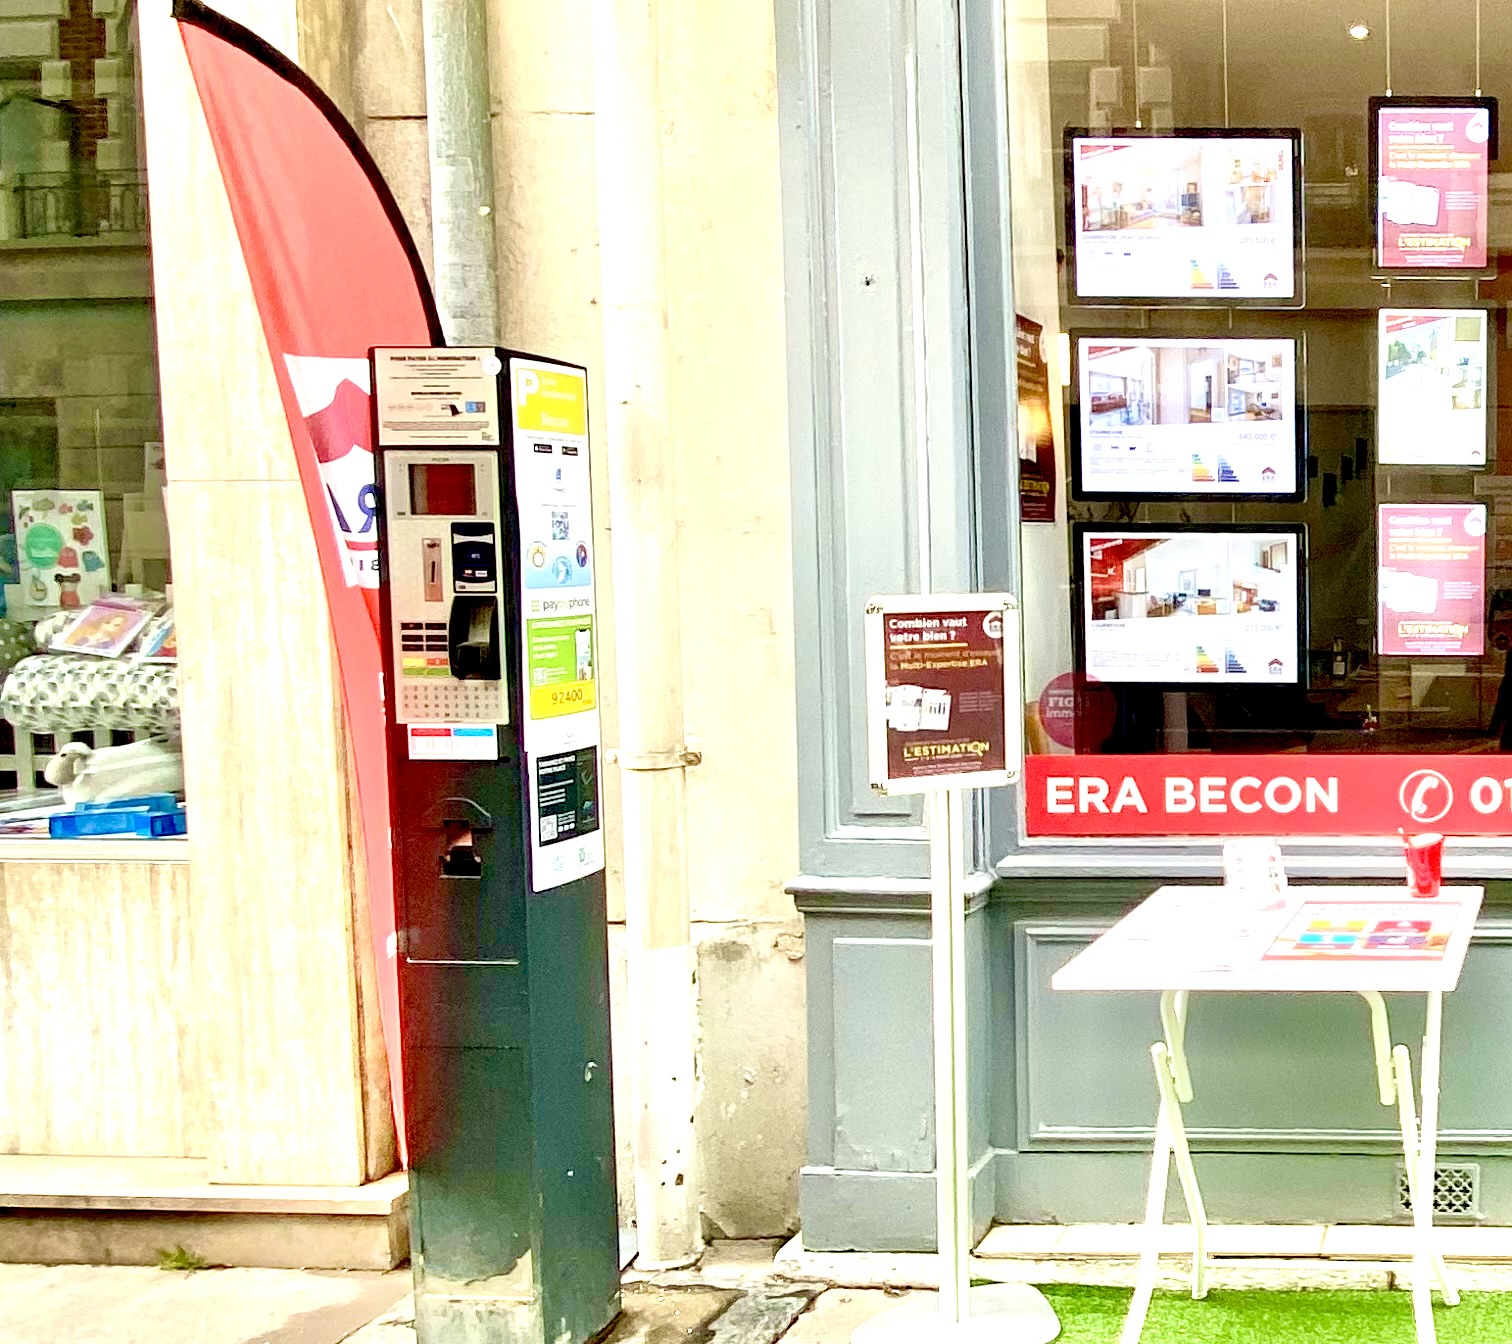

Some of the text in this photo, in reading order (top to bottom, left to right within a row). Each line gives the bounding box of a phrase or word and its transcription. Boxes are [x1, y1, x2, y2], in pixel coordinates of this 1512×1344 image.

[543, 598, 590, 613] payphone
[889, 617, 968, 629] Combien vaut
[889, 632, 920, 643] votre
[922, 631, 947, 641] bien
[551, 688, 583, 707] 92400
[1046, 776, 1149, 814] ERA
[1165, 775, 1338, 814] BECON
